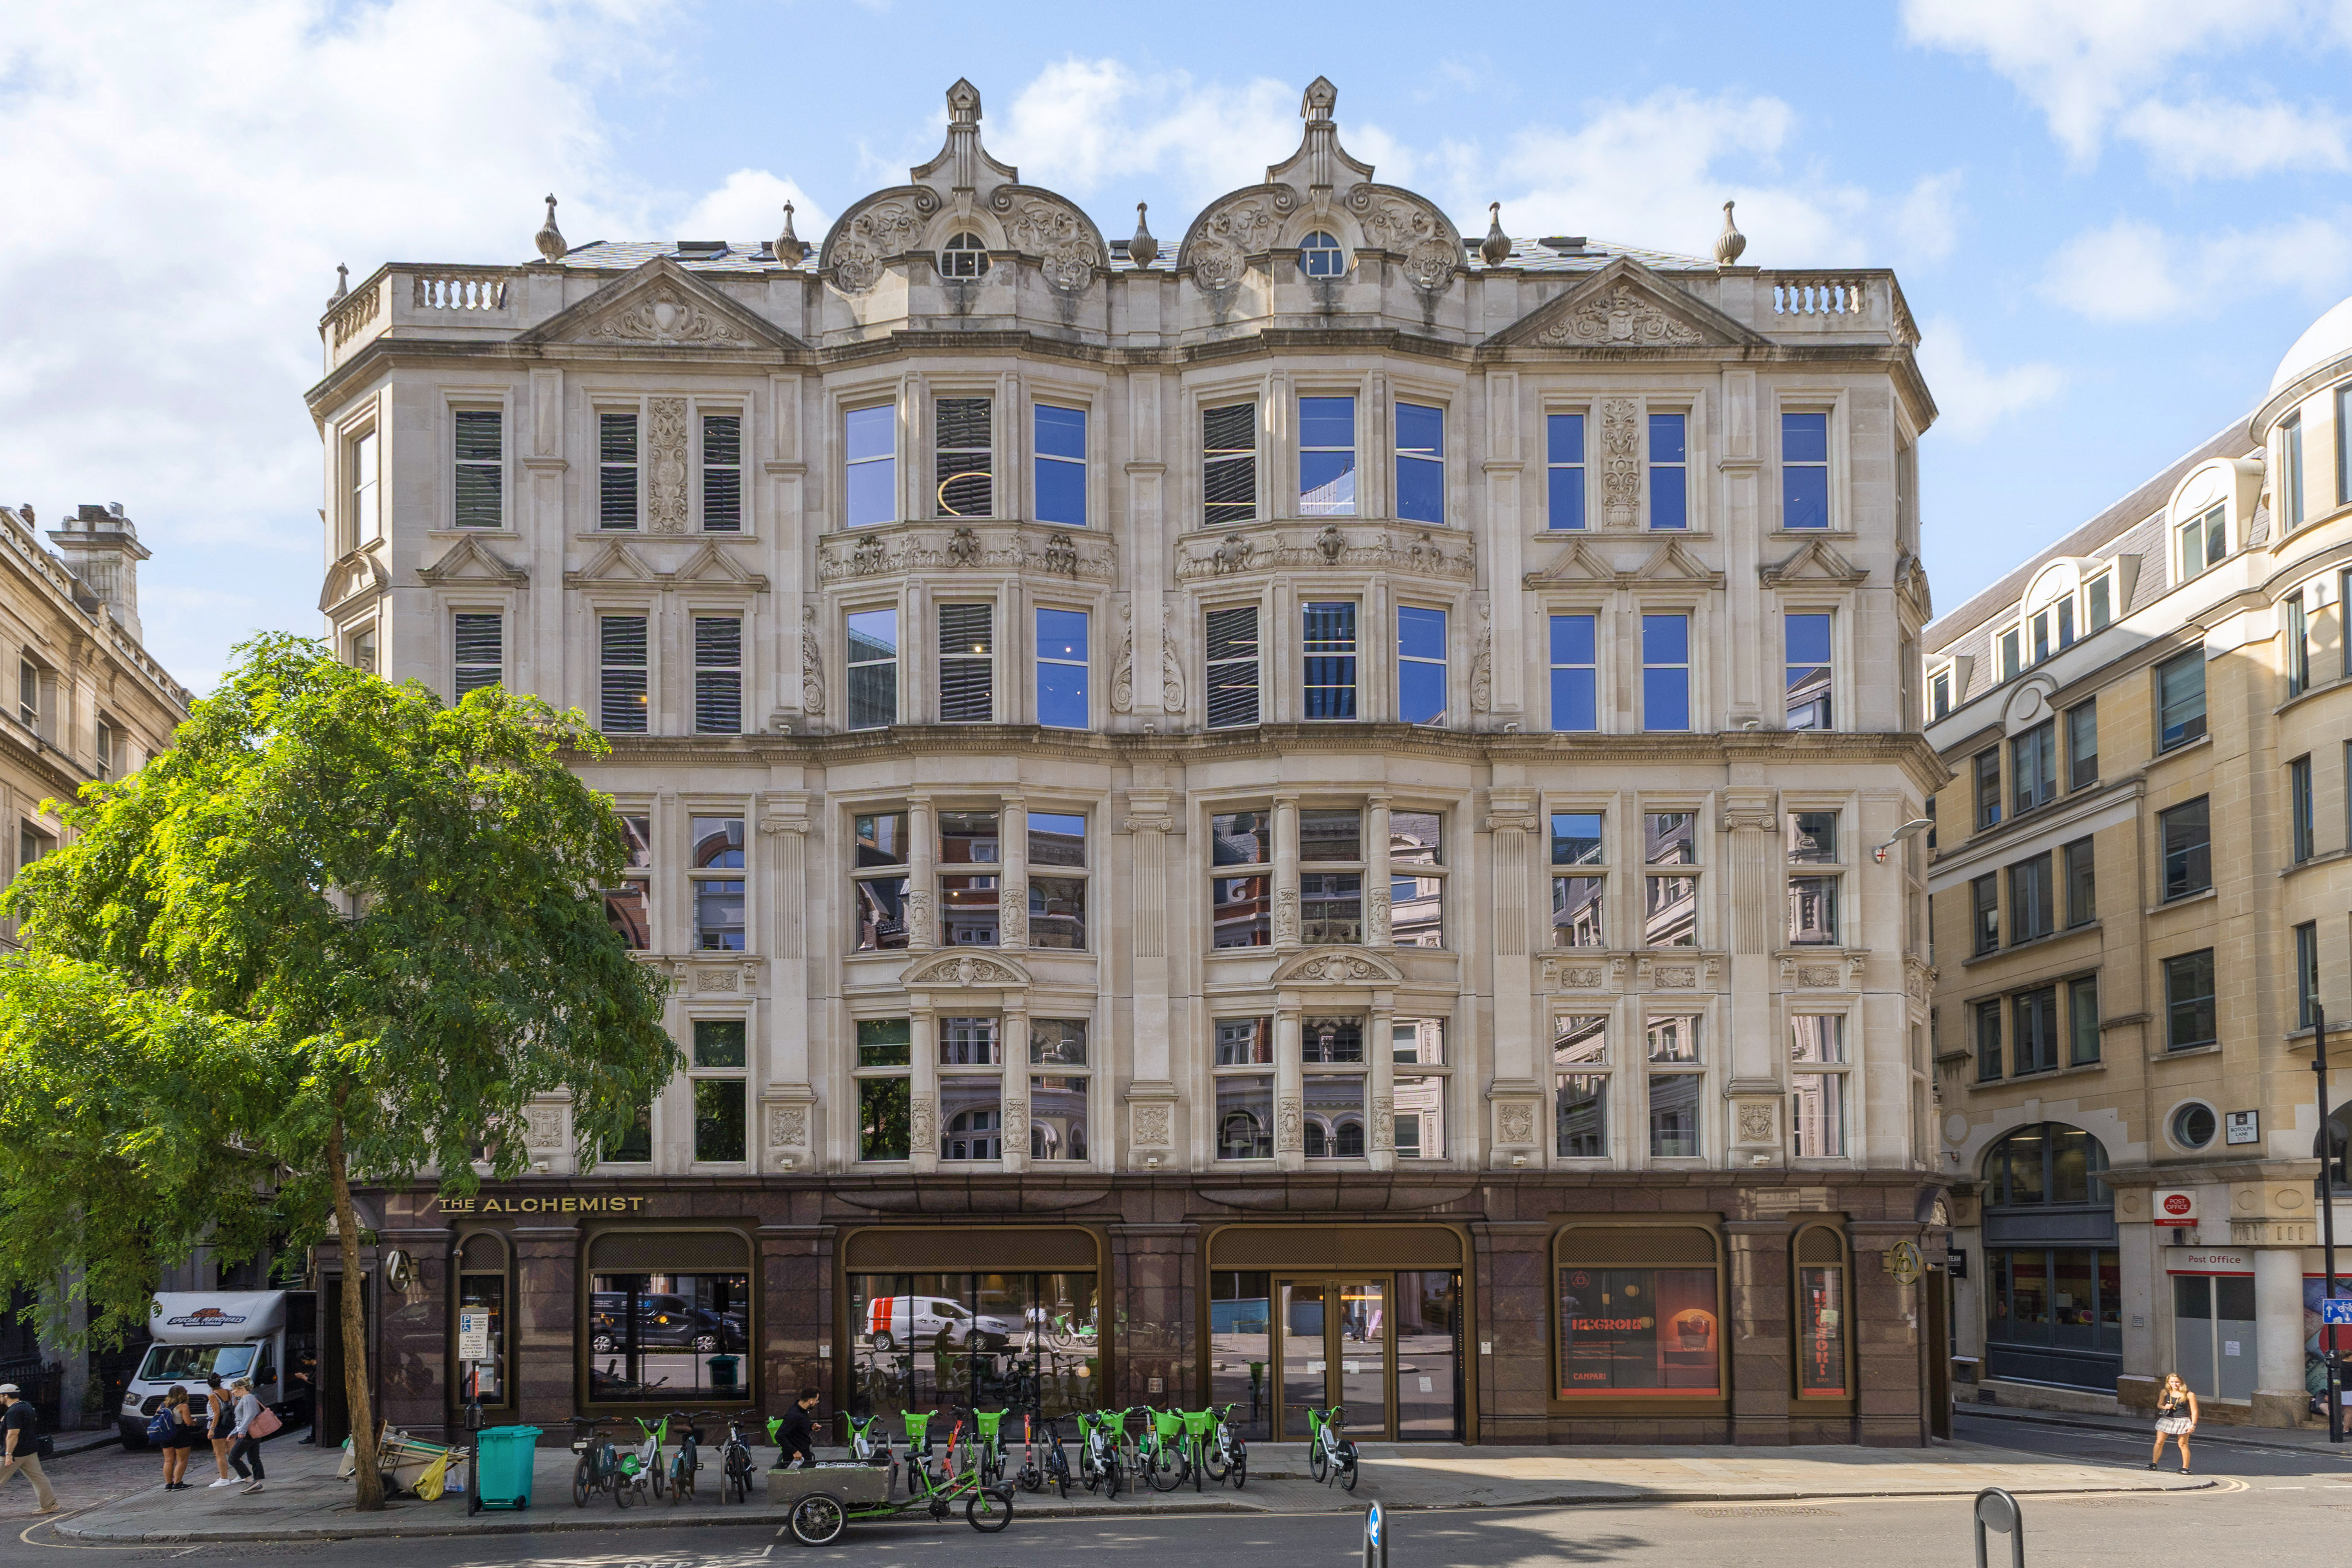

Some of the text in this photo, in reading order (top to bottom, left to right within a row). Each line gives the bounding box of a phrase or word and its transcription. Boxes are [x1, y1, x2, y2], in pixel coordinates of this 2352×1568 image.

[439, 1197, 644, 1212] THE ALCHEMIST
[1572, 1319, 1642, 1330] NEGRONI
